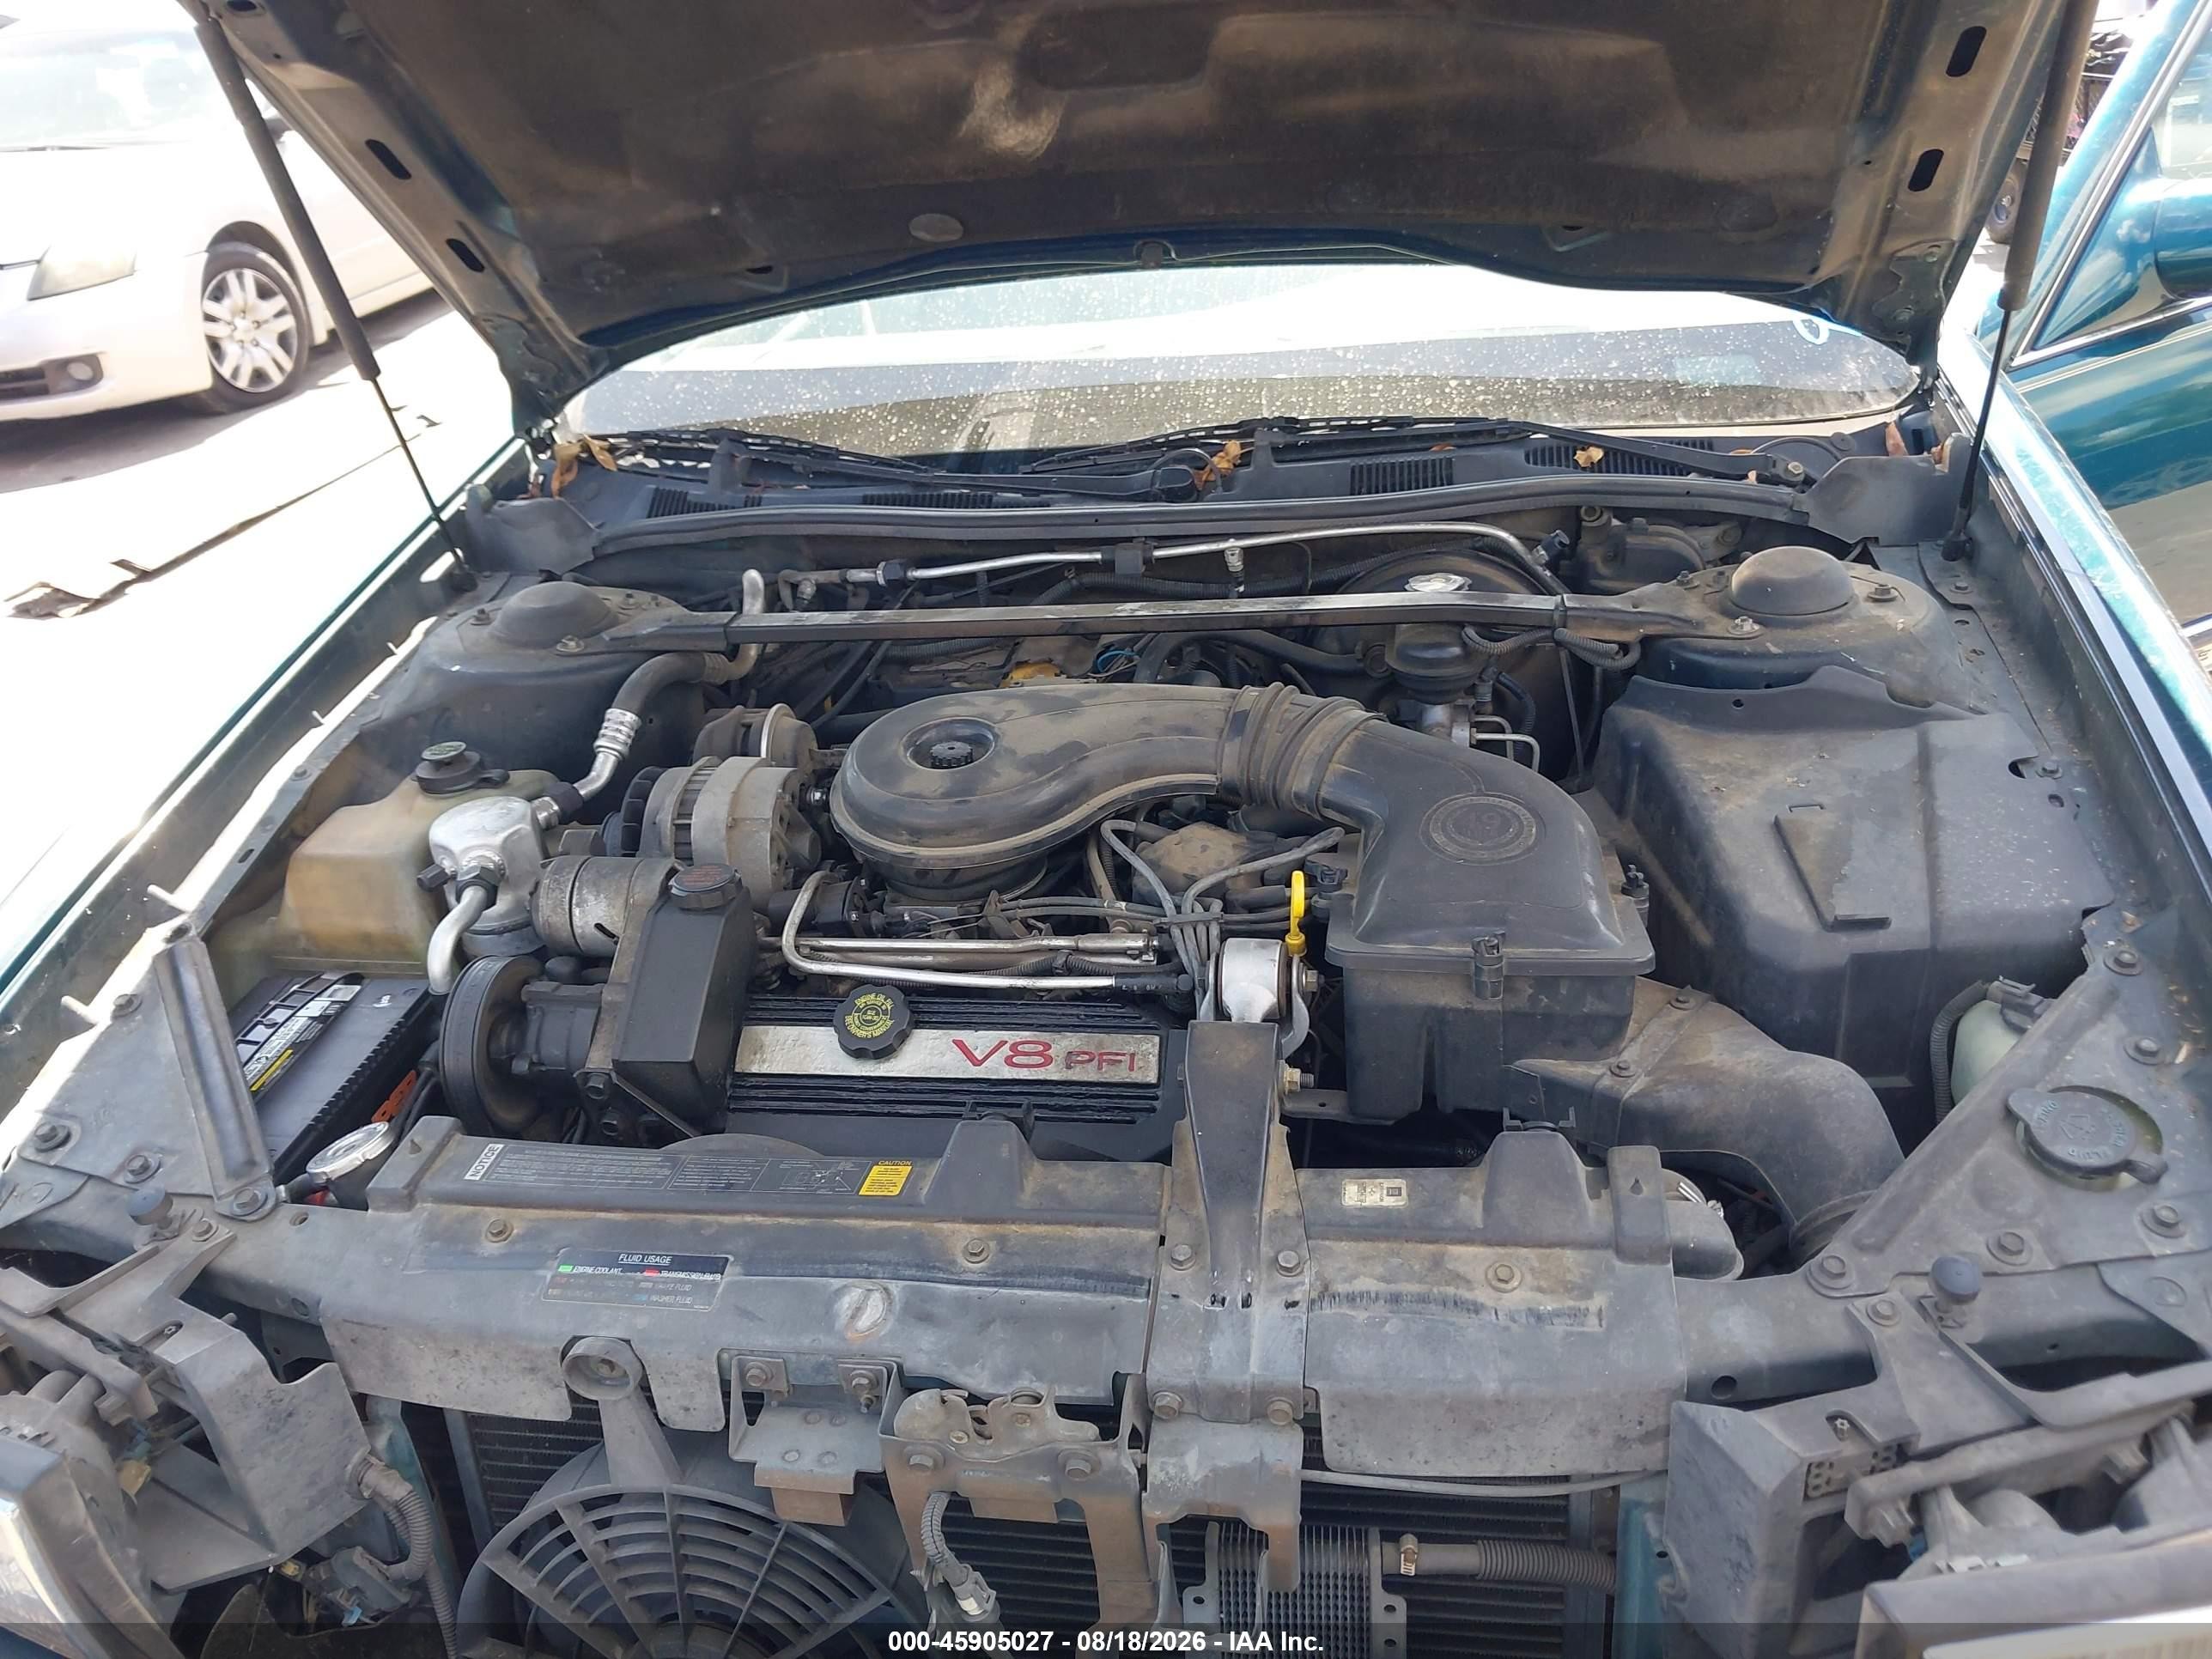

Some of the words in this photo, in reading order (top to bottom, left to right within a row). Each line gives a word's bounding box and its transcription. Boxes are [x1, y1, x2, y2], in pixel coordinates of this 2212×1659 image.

[854, 993, 877, 1005] ENGINE
[878, 994, 886, 1002] OIL
[885, 997, 896, 1008] FILL
[847, 1024, 872, 1038] OWNER'S
[872, 1018, 896, 1038] MANUAL
[951, 1038, 1054, 1069] V8
[1064, 1049, 1136, 1073] PFI
[470, 1146, 499, 1176] NOTICE
[618, 1253, 642, 1262] FLUID
[643, 1255, 673, 1264] USAGE
[573, 1266, 596, 1274] ENGINE
[596, 1267, 623, 1275] COOLANT
